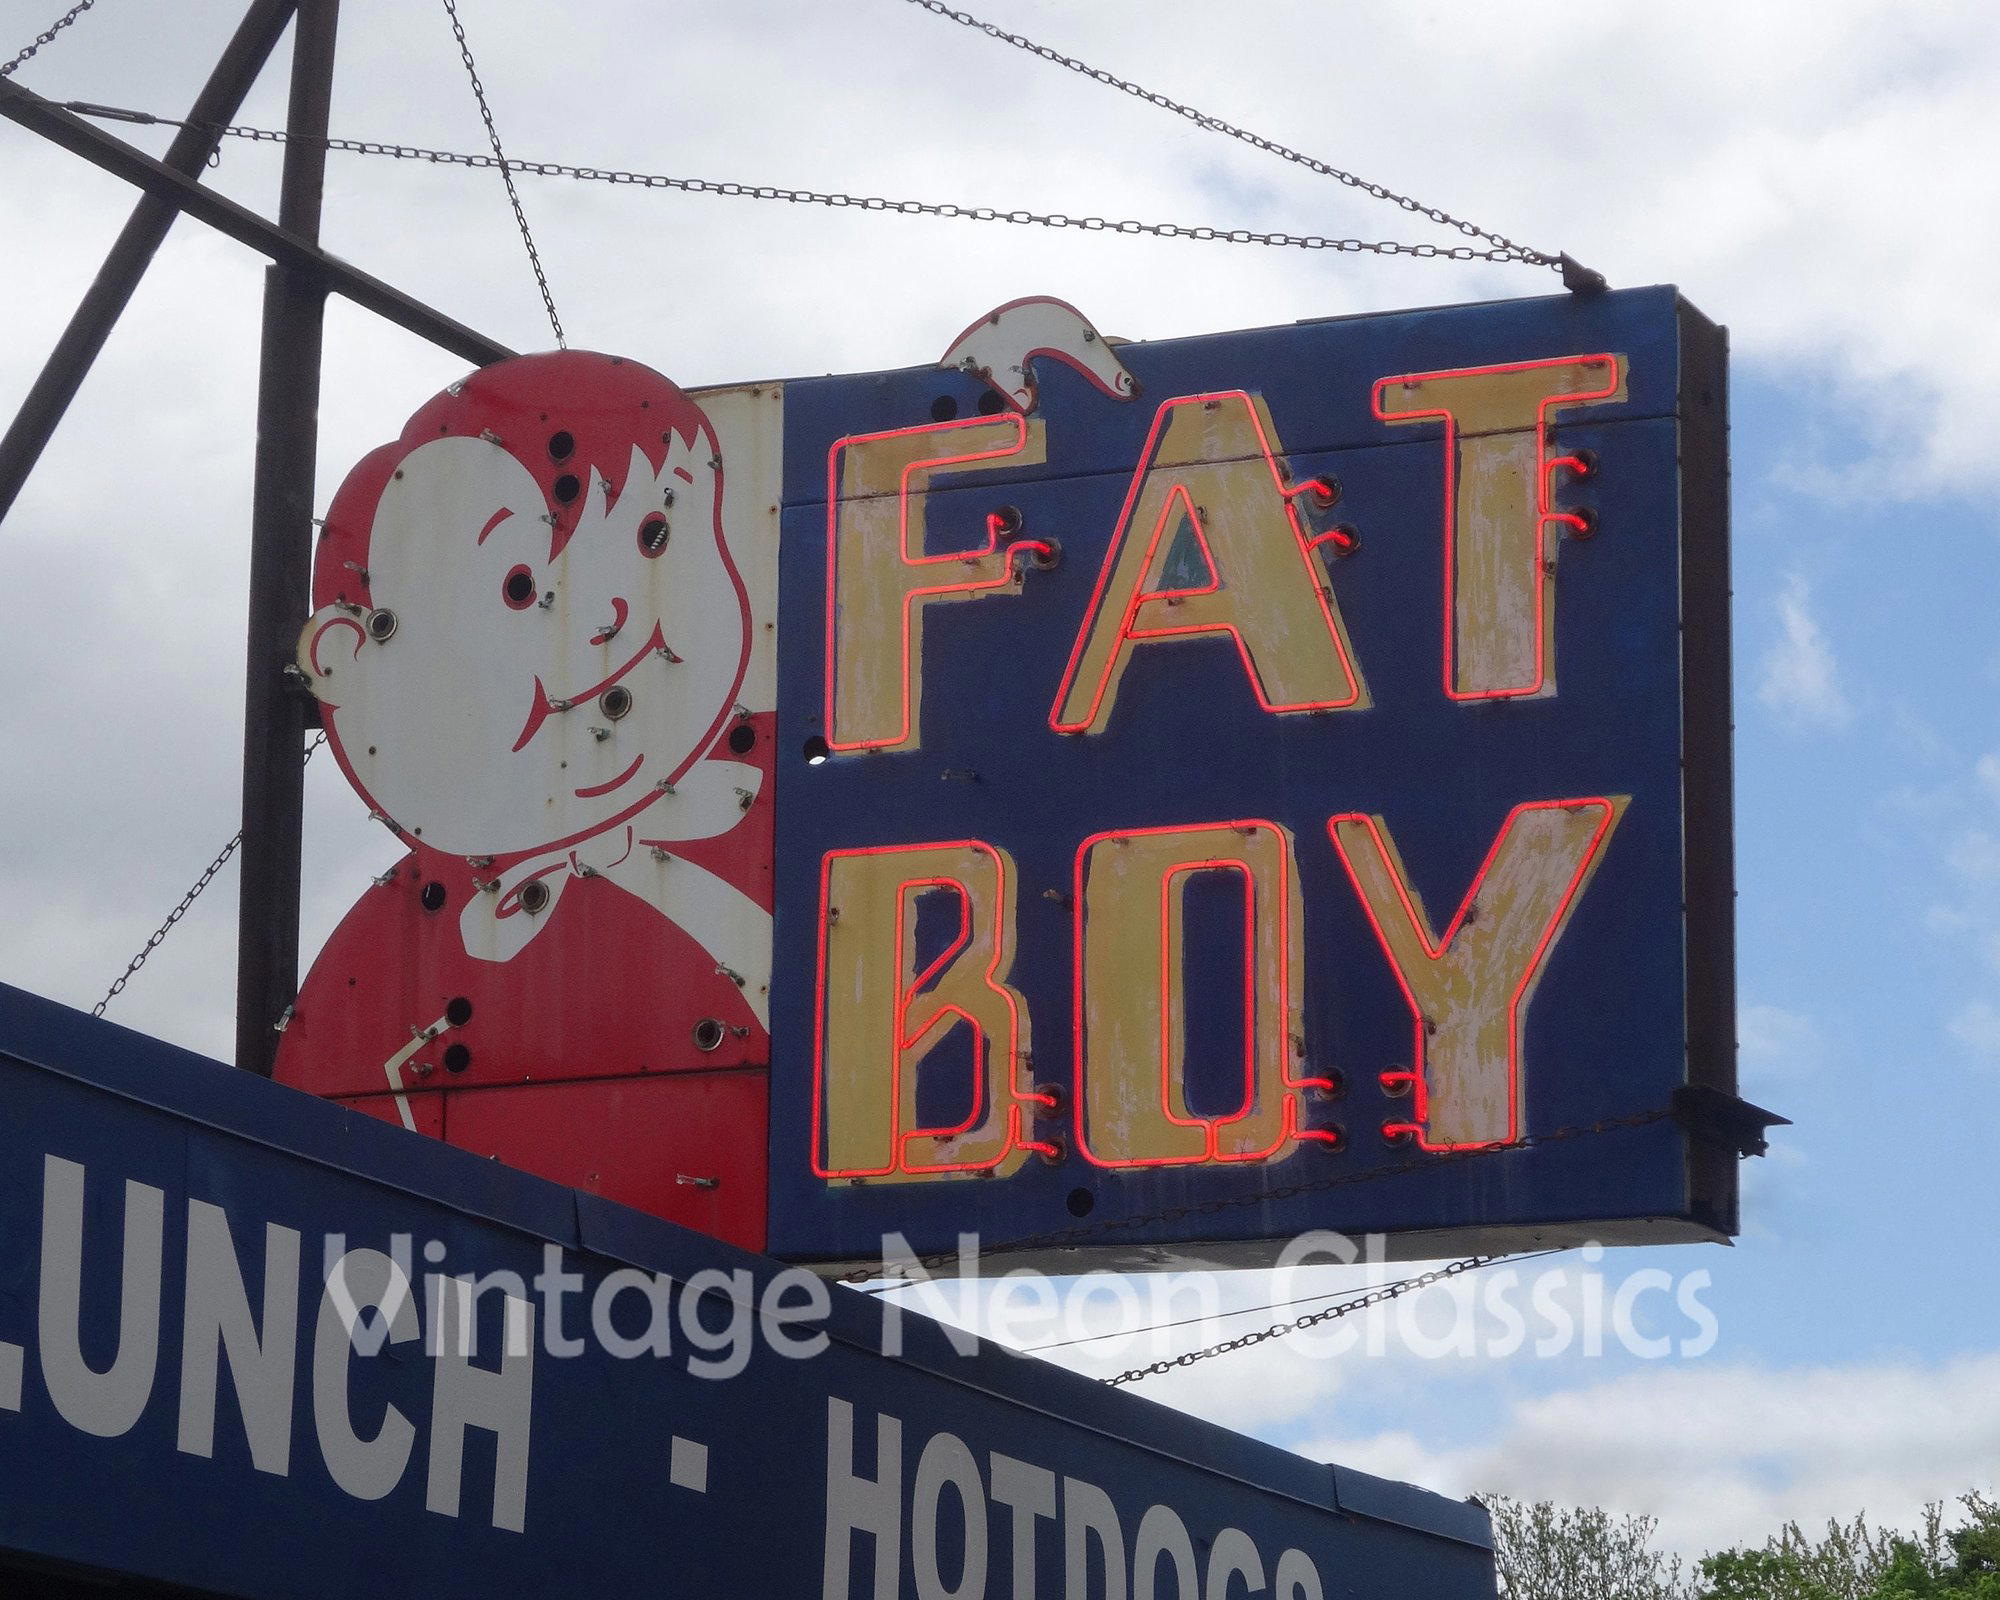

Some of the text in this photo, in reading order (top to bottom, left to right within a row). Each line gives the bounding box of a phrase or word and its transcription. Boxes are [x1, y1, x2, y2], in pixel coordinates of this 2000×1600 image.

[826, 353, 1630, 751] FAT
[811, 793, 1632, 1188] BOY
[0, 1153, 1324, 1600] UNCH HOTD
